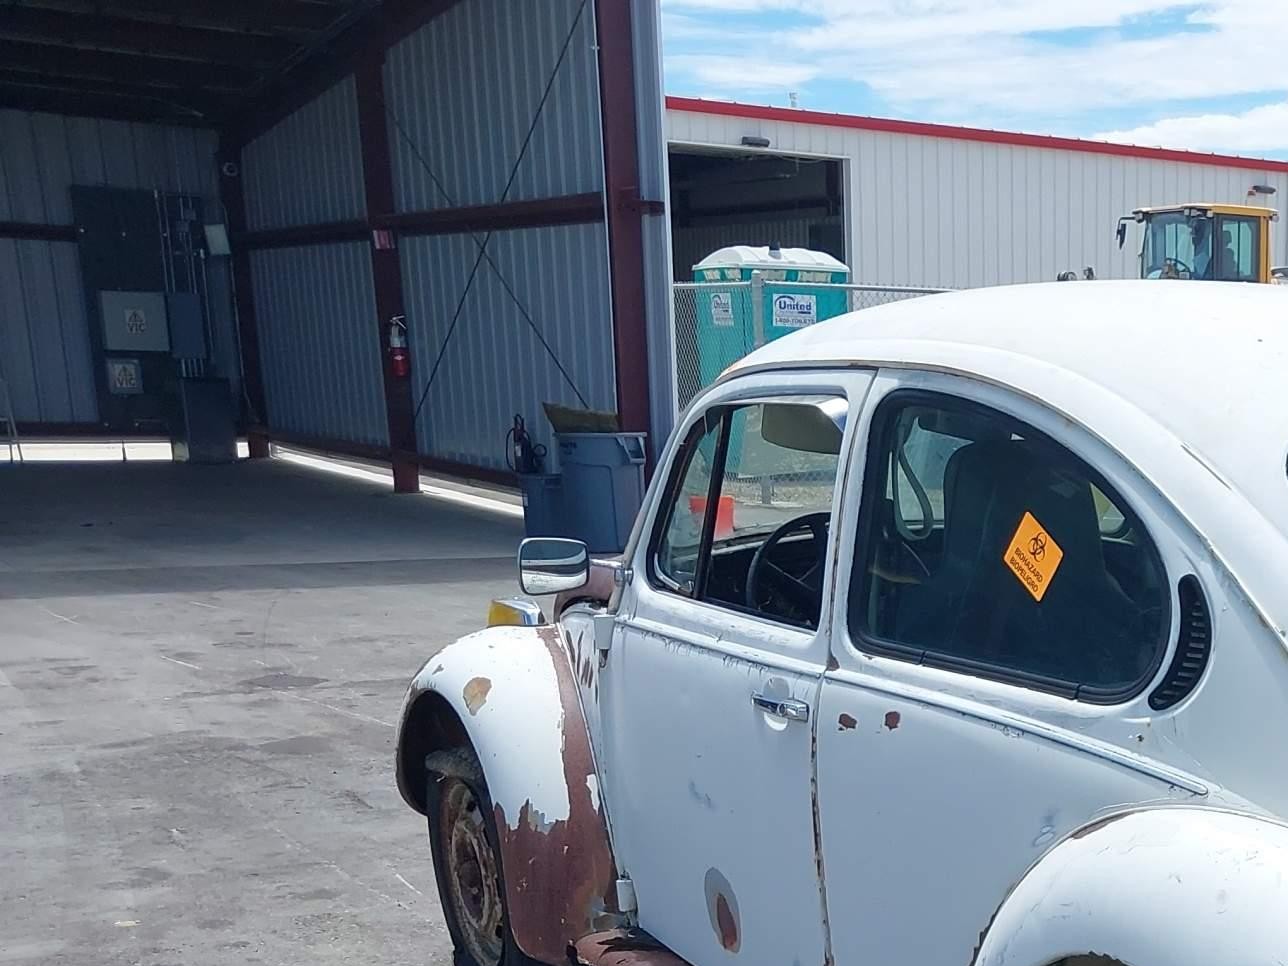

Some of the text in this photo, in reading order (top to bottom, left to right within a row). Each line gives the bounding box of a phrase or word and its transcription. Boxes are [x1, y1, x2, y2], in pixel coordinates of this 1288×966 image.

[779, 300, 811, 310] United
[1010, 556, 1038, 592] BIOPELIGRO
[1015, 547, 1043, 583] BIOHAZARD
